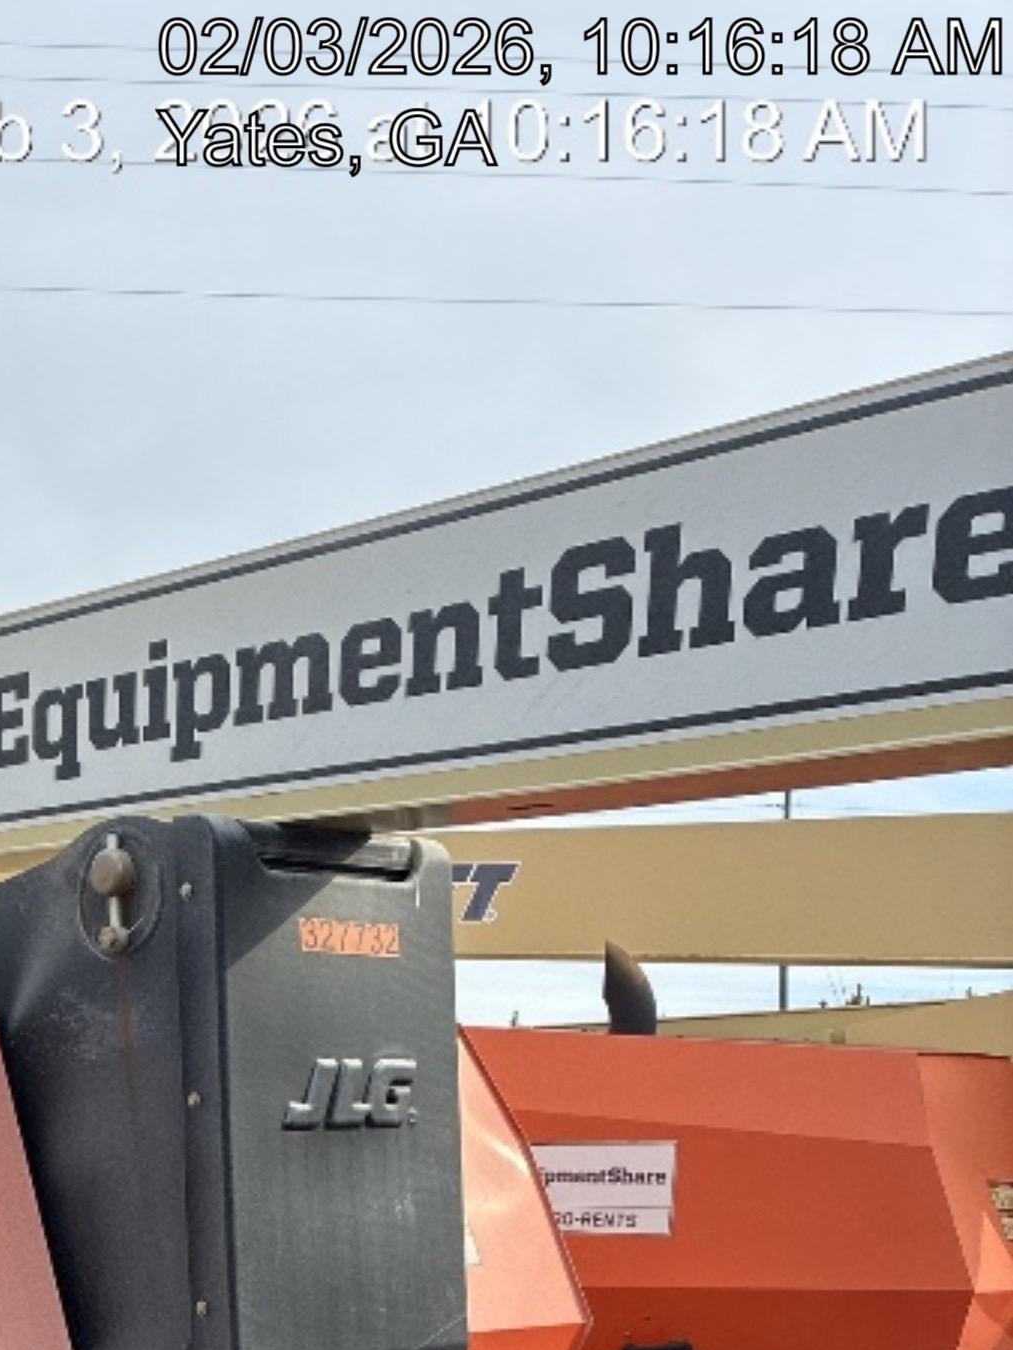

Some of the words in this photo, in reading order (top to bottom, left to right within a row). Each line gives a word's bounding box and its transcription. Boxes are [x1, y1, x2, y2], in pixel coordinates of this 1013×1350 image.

[302, 919, 396, 955] 327732
[281, 1057, 417, 1130] JLG
[539, 1165, 667, 1188] pmentShare
